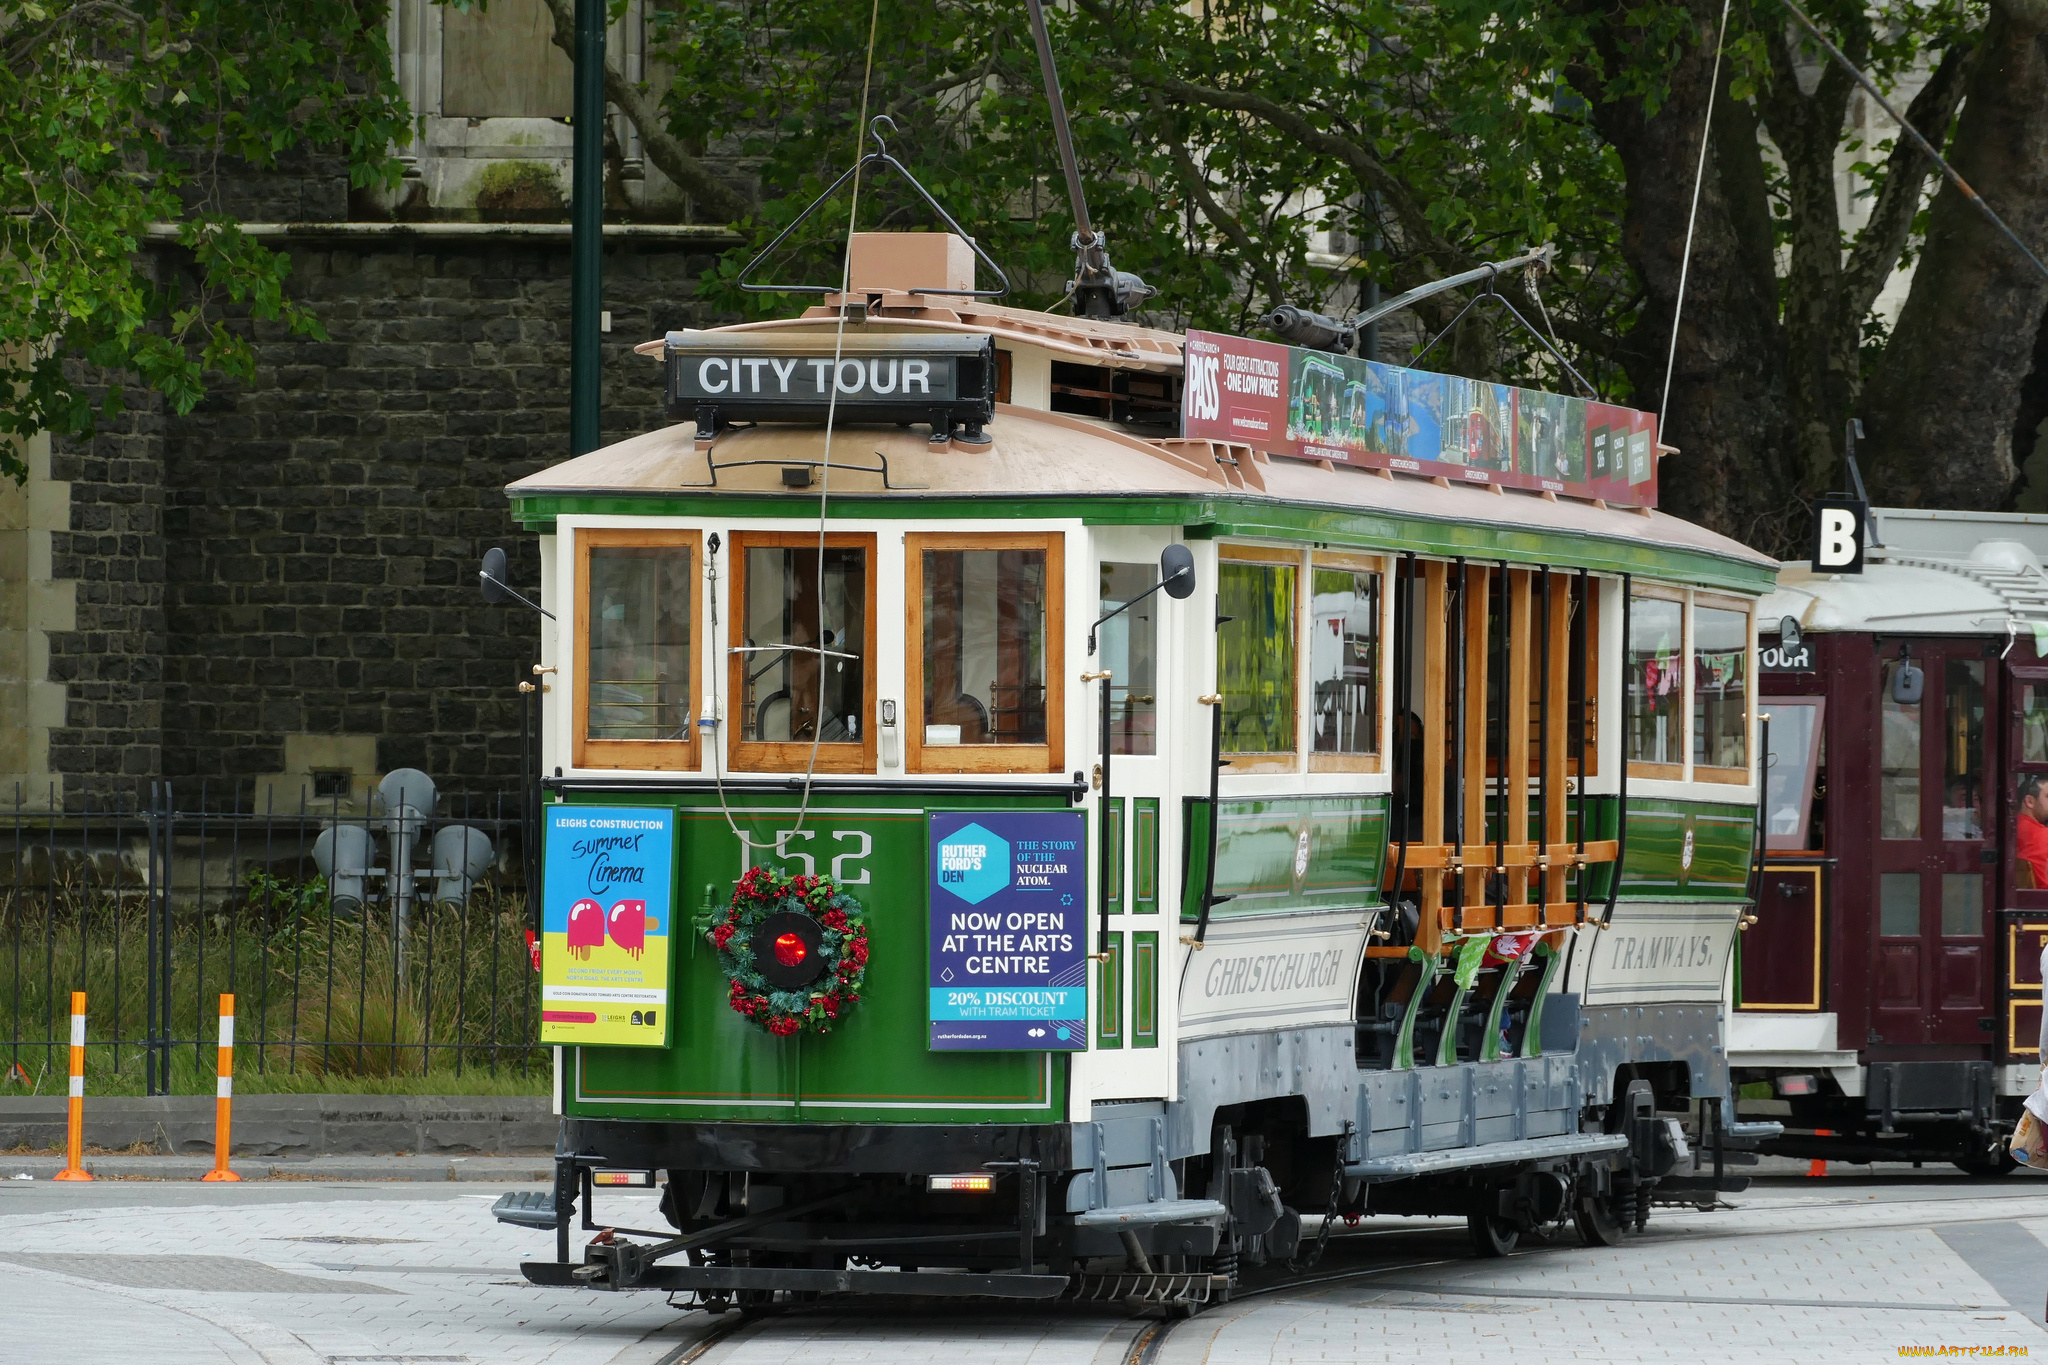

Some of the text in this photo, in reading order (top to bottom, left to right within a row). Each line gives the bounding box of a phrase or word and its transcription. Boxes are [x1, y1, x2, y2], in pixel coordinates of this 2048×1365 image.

[1224, 353, 1279, 378] FOUR GREAT ATTRACTIONS
[699, 357, 930, 394] CITY TOUR
[1188, 353, 1219, 421] PASS
[1227, 372, 1241, 393] ONE
[1243, 374, 1258, 395] LOW
[1259, 377, 1279, 398] PRICE
[1820, 508, 1857, 566] B
[556, 818, 663, 830] LEIGHS CONSTRUCTION
[942, 844, 986, 858] RUTHER
[1017, 841, 1077, 851] THE STORY
[732, 830, 872, 884] 152
[942, 857, 982, 871] FORD'S
[1017, 853, 1056, 862] OF THE
[588, 852, 645, 895] Cinema
[942, 870, 965, 883] DEN
[1016, 864, 1068, 874] NUCLEAR
[1016, 876, 1051, 886] ATOM.
[951, 912, 1064, 931] NOW OPEN
[942, 934, 1073, 952] AT THE ARTS
[966, 956, 1050, 974] CENTRE
[1205, 950, 1343, 998] CHRISTCHURCH
[948, 992, 1068, 1006] 20% DISCOUNT
[960, 1007, 1056, 1017] WITH TRAM TICKET
